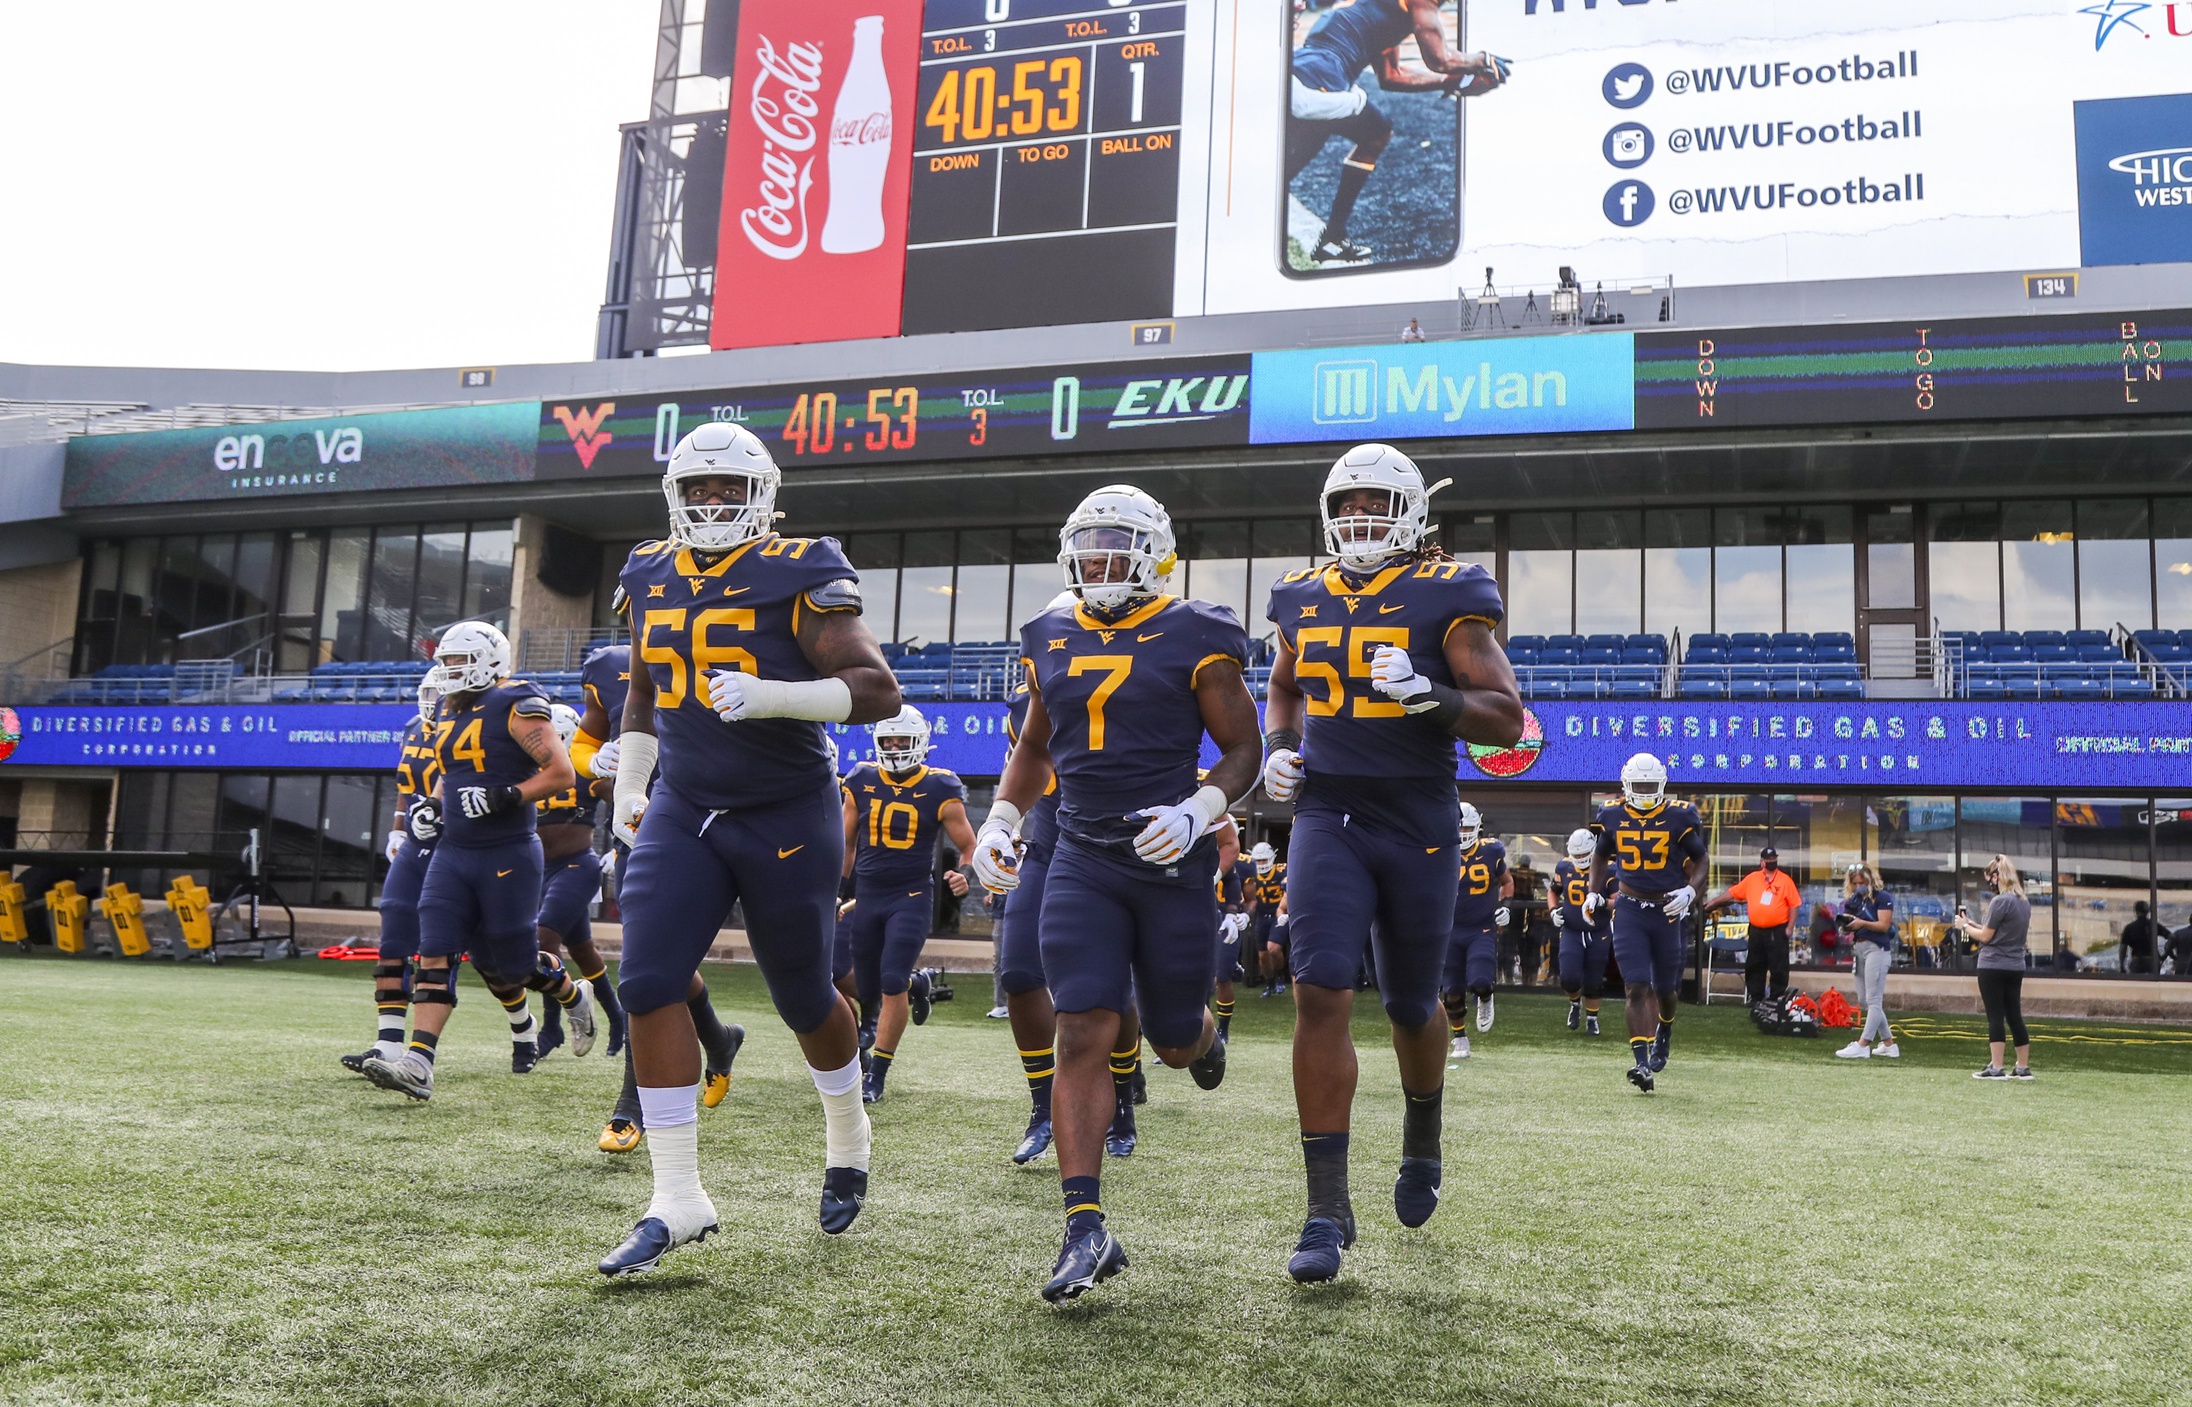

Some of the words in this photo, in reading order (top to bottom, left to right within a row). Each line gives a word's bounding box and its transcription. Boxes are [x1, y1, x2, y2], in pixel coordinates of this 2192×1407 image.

[932, 37, 972, 54] T.O.L.
[984, 29, 996, 52] 3
[1065, 21, 1108, 38] T.O.L.
[1128, 11, 1140, 34] 3
[1121, 41, 1160, 60] QTR.
[1129, 62, 1145, 123] 1
[1666, 51, 1919, 95] @WVUFootball
[925, 56, 1082, 143] 40:53
[1017, 147, 1042, 163] TO
[1044, 143, 1069, 161] GO
[1101, 138, 1142, 156] BALL
[1144, 134, 1172, 151] ON
[1668, 110, 1922, 154] @WVUFootball
[929, 152, 980, 172] DOWN
[1668, 172, 1926, 216] @WVUFootball
[2037, 279, 2066, 296] 134
[1143, 328, 1161, 343] 97
[961, 389, 1004, 407] T.O.L.
[1112, 374, 1247, 418] EKU
[1384, 363, 1568, 422] Mylan
[1695, 339, 1717, 417] DOWN
[711, 404, 749, 422] T.O.L.
[782, 386, 919, 456] 40:53
[968, 408, 987, 446] 3
[1051, 376, 1079, 441] 0
[653, 402, 680, 462] 0
[232, 472, 337, 488] INSURANCE
[641, 608, 758, 709] 56
[1296, 626, 1410, 718] 55
[32, 716, 162, 733] DIVERSIFIED
[172, 716, 211, 733] GAS
[220, 716, 232, 733] &
[242, 715, 279, 733] OIL
[1067, 655, 1134, 750] 7
[434, 718, 487, 775] 74
[1565, 715, 1815, 738] DIVERSIFIED
[1835, 715, 1907, 738] GAS
[1927, 716, 1947, 738] &
[1968, 715, 2033, 739] OIL
[869, 798, 919, 850] 10
[1616, 830, 1670, 871] 53
